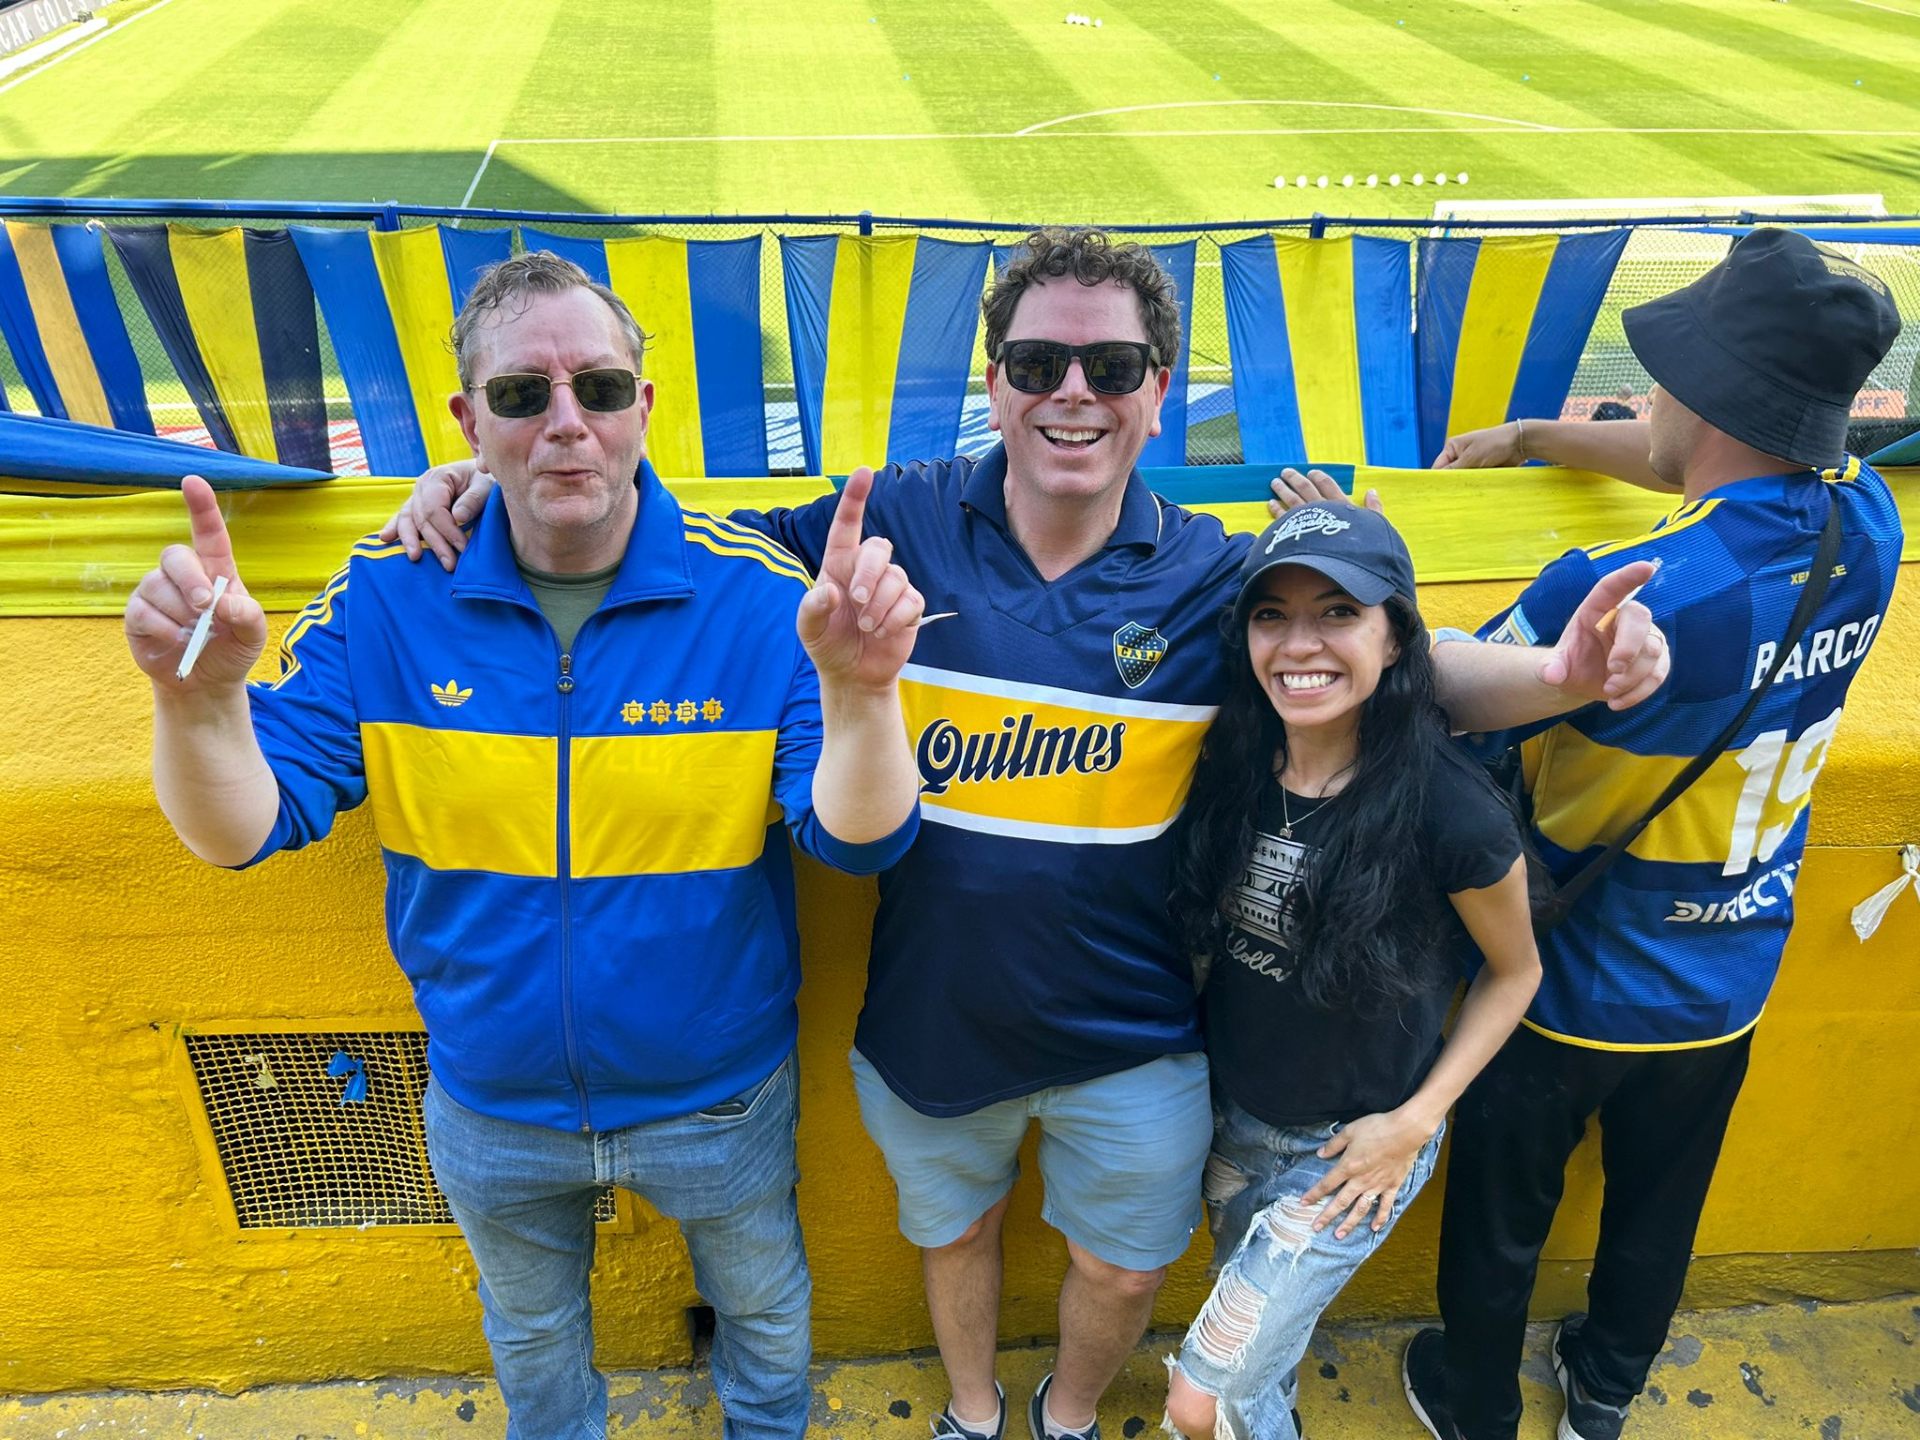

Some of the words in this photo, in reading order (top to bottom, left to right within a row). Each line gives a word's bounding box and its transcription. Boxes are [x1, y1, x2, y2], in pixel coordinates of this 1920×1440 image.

[1120, 646, 1157, 661] CABJ
[1750, 613, 1880, 690] BARCO
[626, 702, 720, 720] CABJ
[916, 713, 1126, 796] Quilmes
[1721, 706, 1842, 877] 19
[1663, 858, 1803, 924] DIRECT
